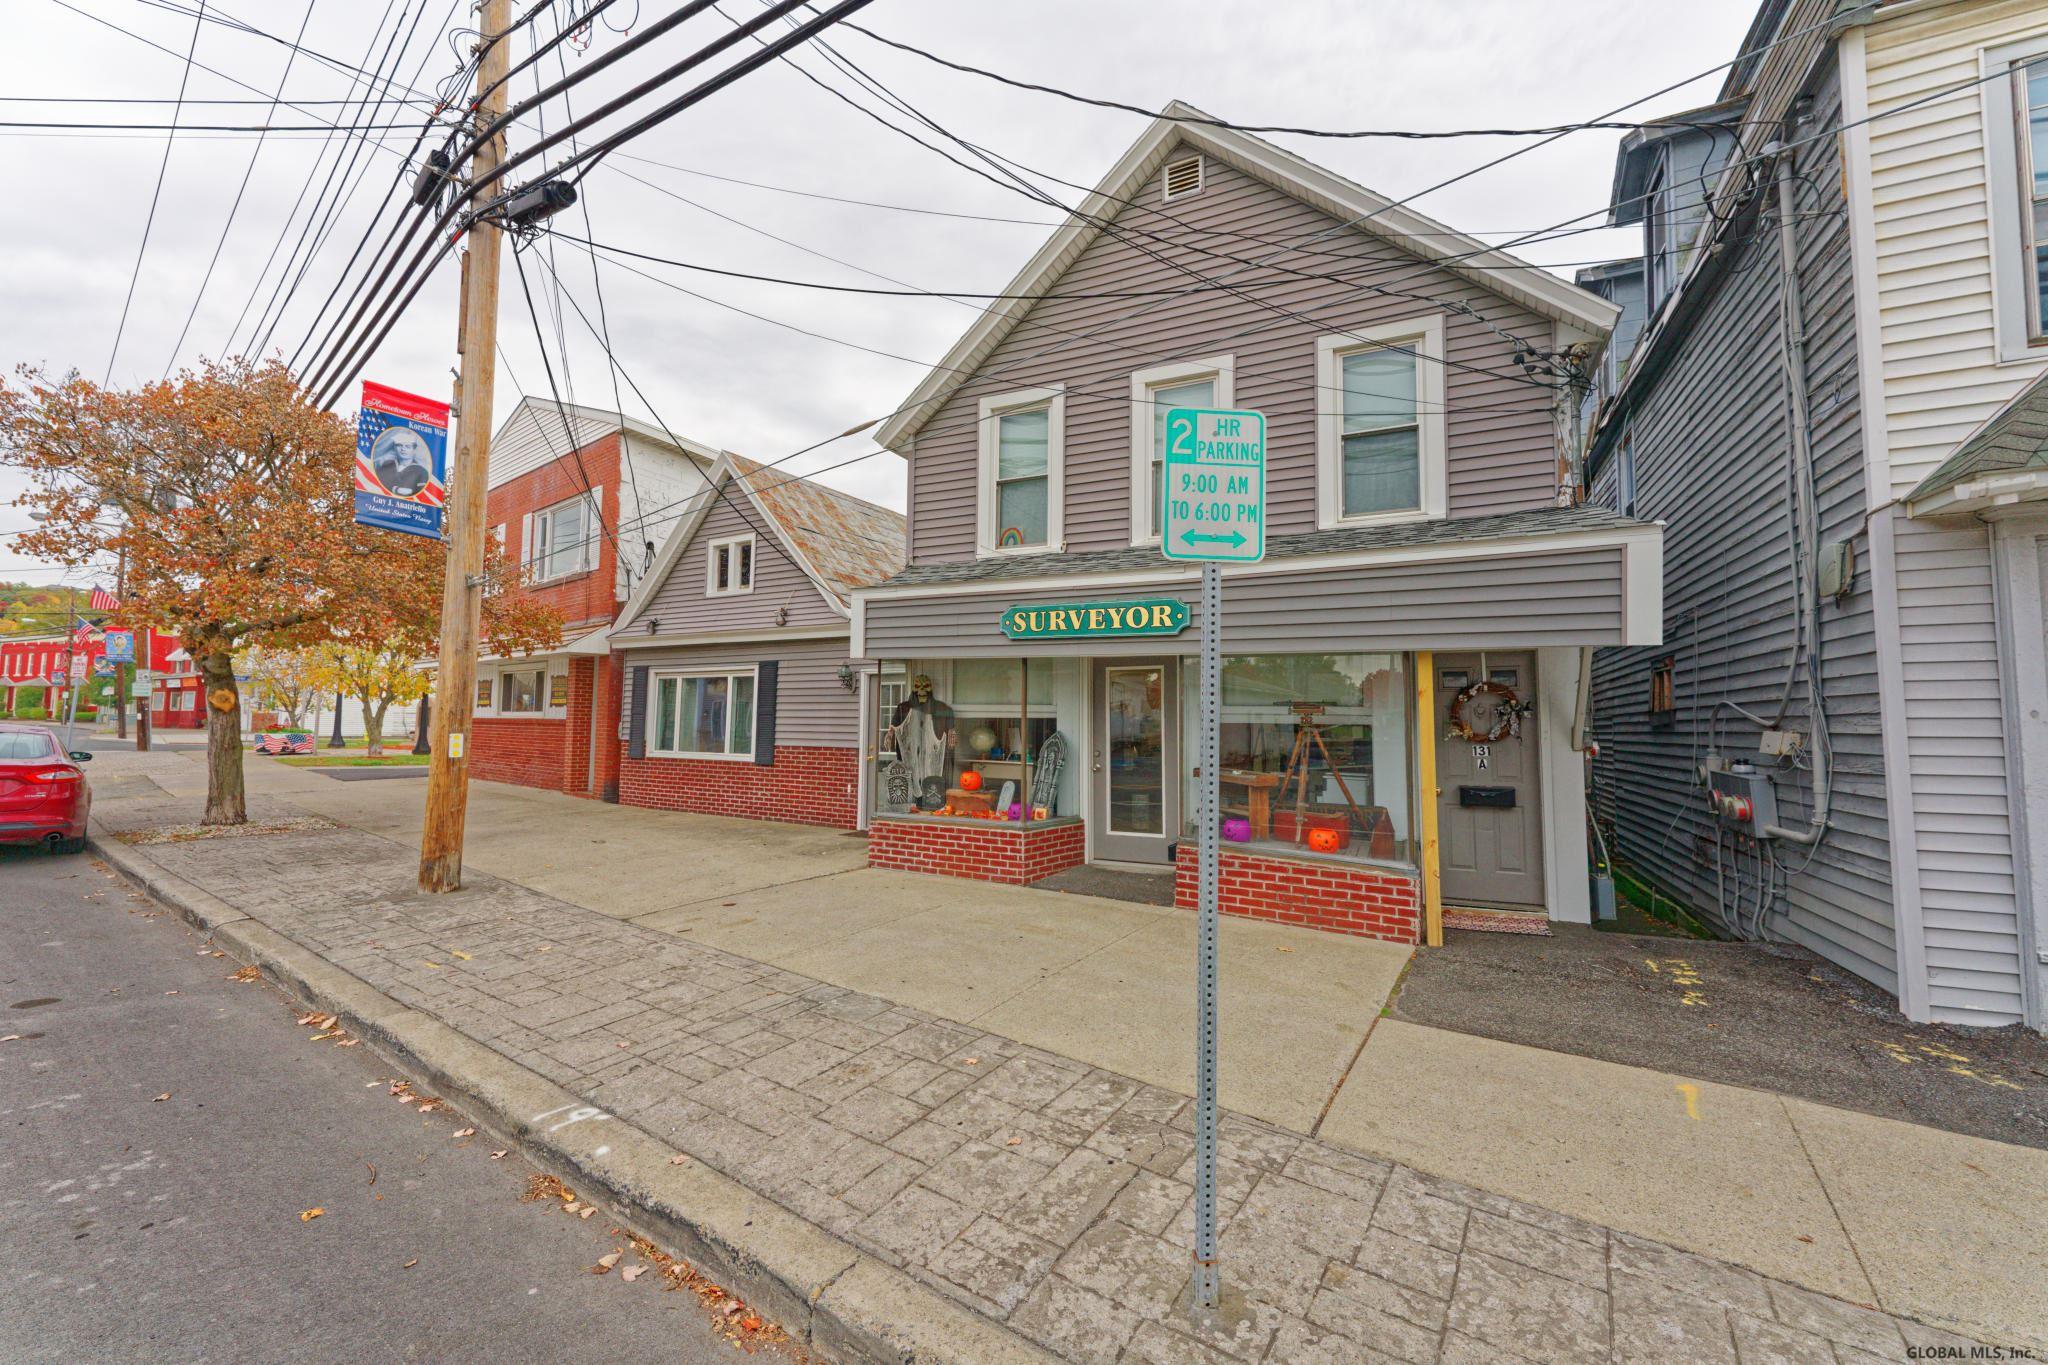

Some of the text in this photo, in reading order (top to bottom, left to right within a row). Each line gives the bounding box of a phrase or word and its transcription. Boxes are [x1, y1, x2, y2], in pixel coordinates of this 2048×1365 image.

[365, 398, 446, 426] Hometown Heroes
[409, 421, 447, 437] Korean War
[1171, 418, 1241, 455] 2 HR
[1197, 440, 1260, 461] PARKING
[1181, 473, 1249, 494] 9:00 AM
[365, 504, 432, 525] United States Navy
[1171, 500, 1258, 523] TO 6:00 PM
[1012, 605, 1174, 632] SURVEYOR
[1472, 745, 1491, 757] 131
[1479, 758, 1487, 769] A
